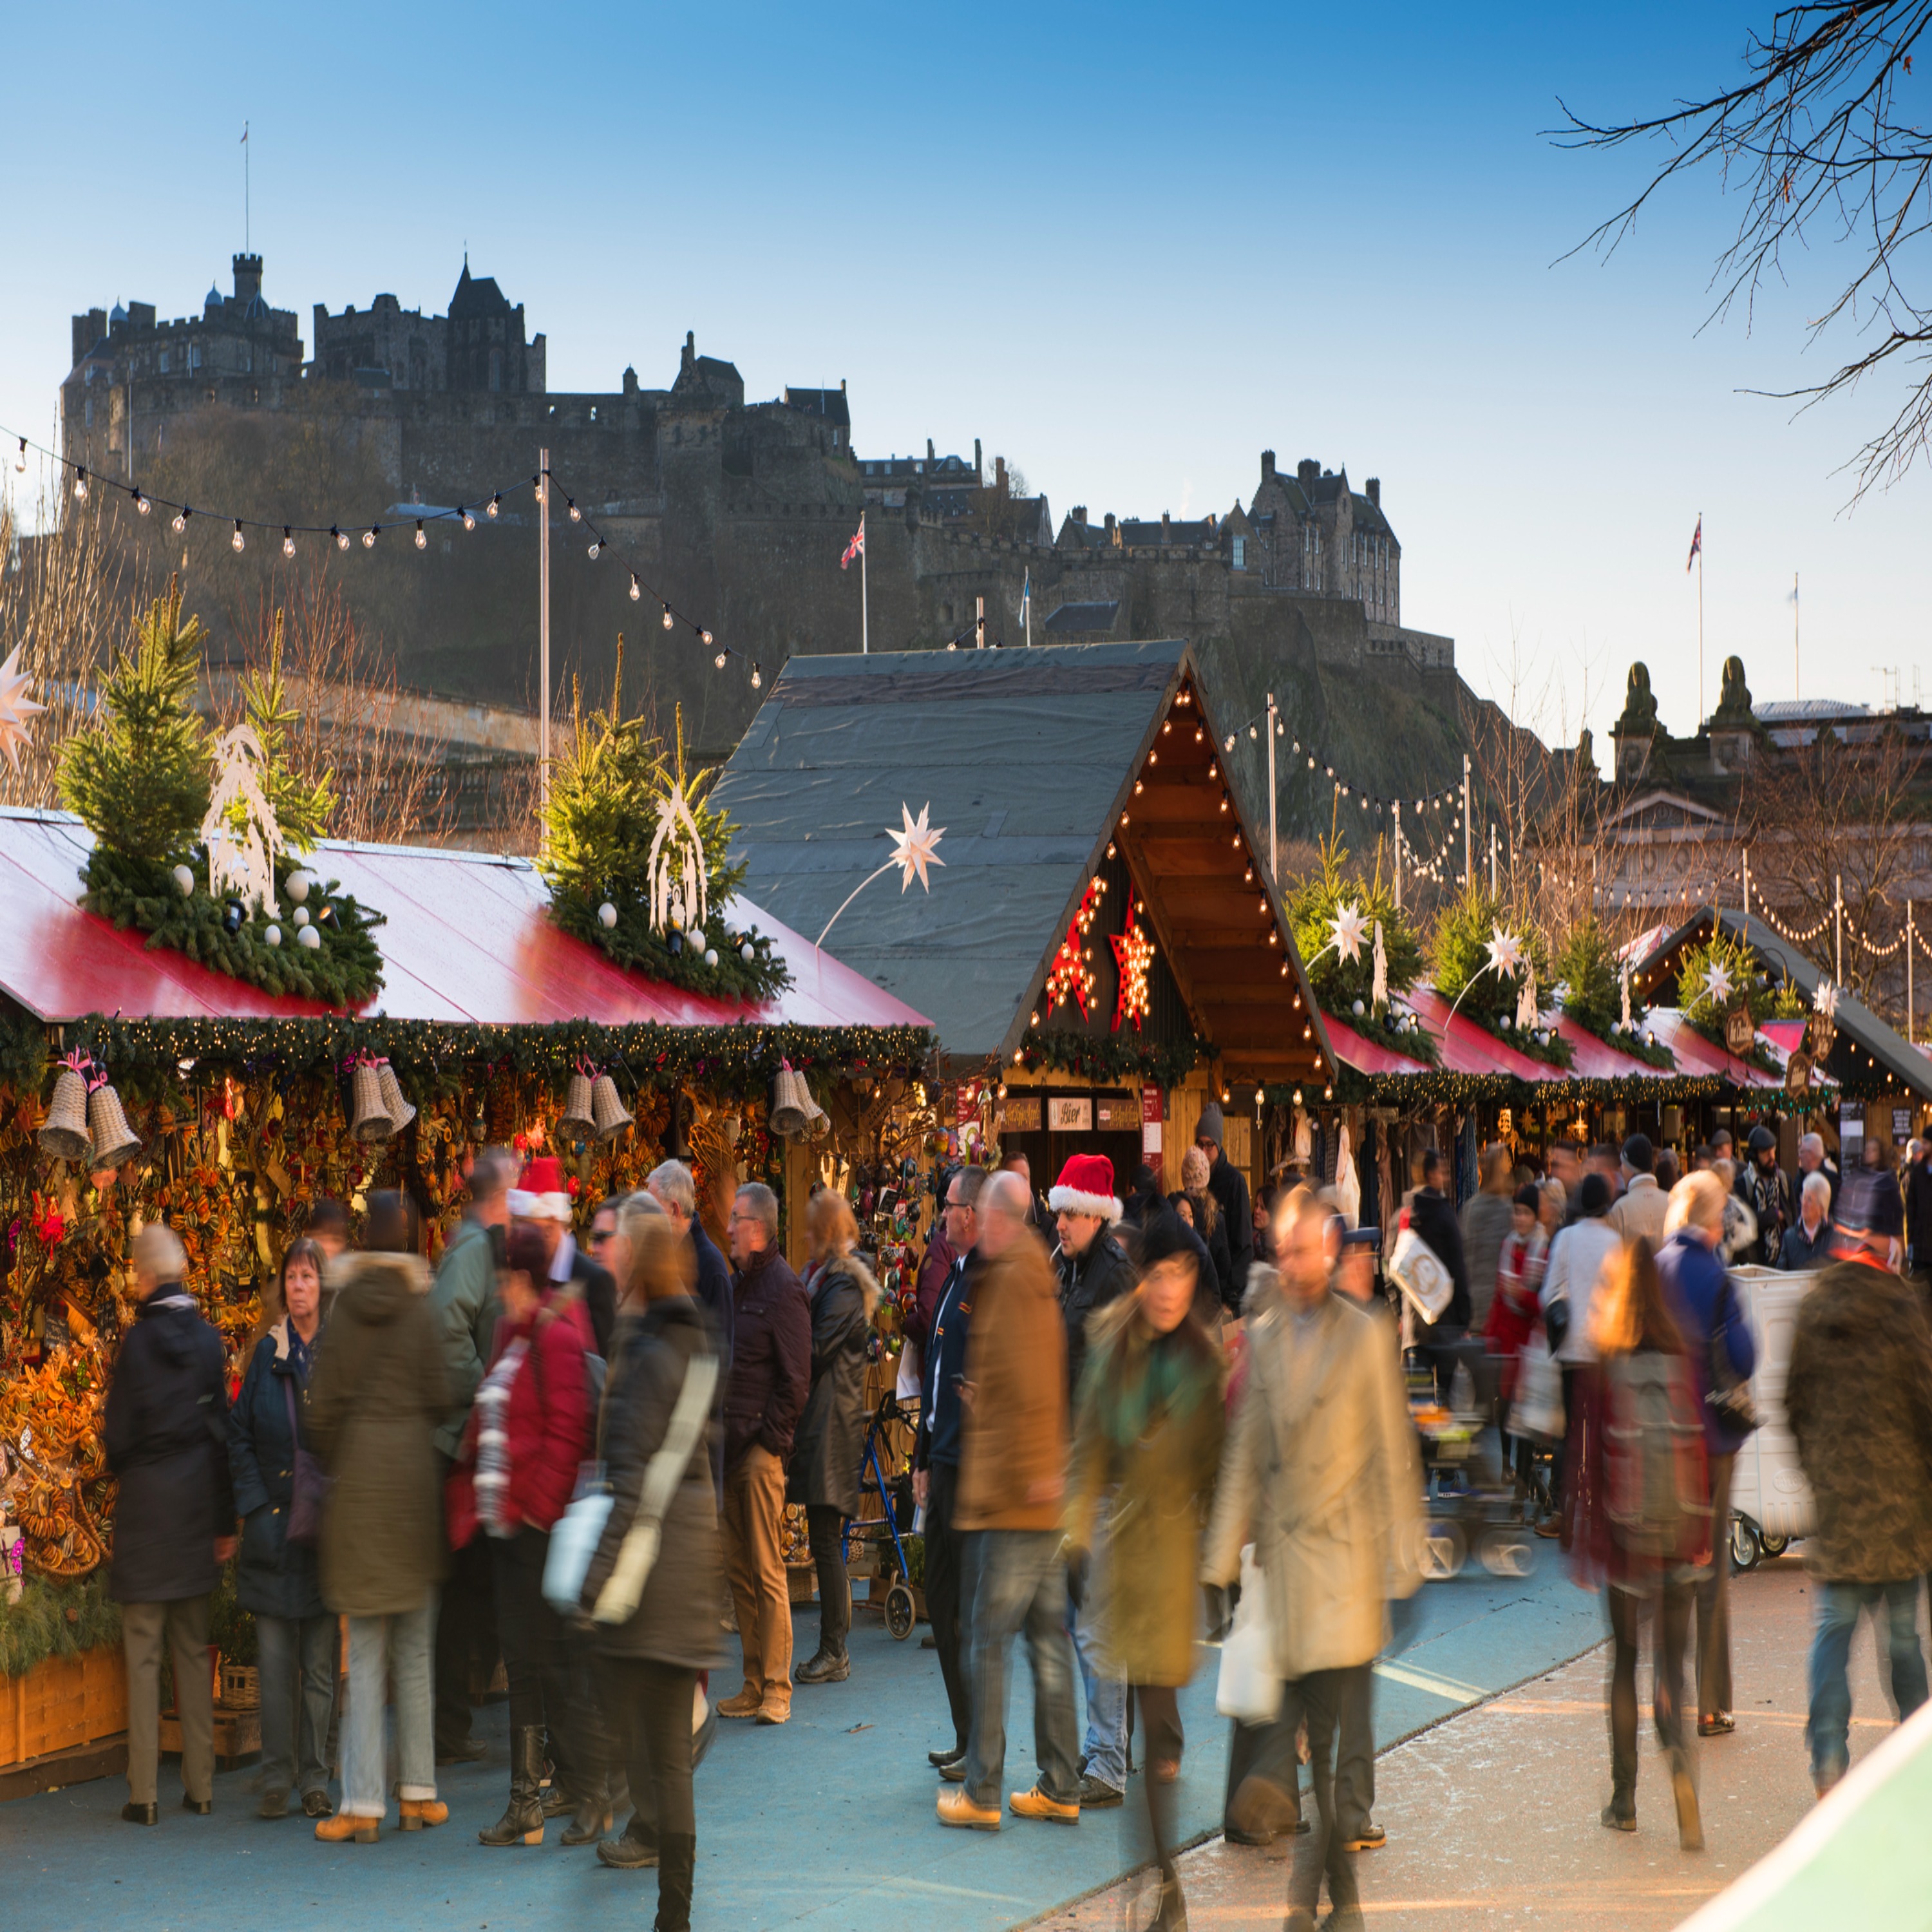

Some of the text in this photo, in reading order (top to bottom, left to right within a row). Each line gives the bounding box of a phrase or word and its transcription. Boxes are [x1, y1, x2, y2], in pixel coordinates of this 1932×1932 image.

[868, 1095, 891, 1126] GARDEN
[876, 1093, 887, 1107] THE
[1061, 1103, 1081, 1124] Bier
